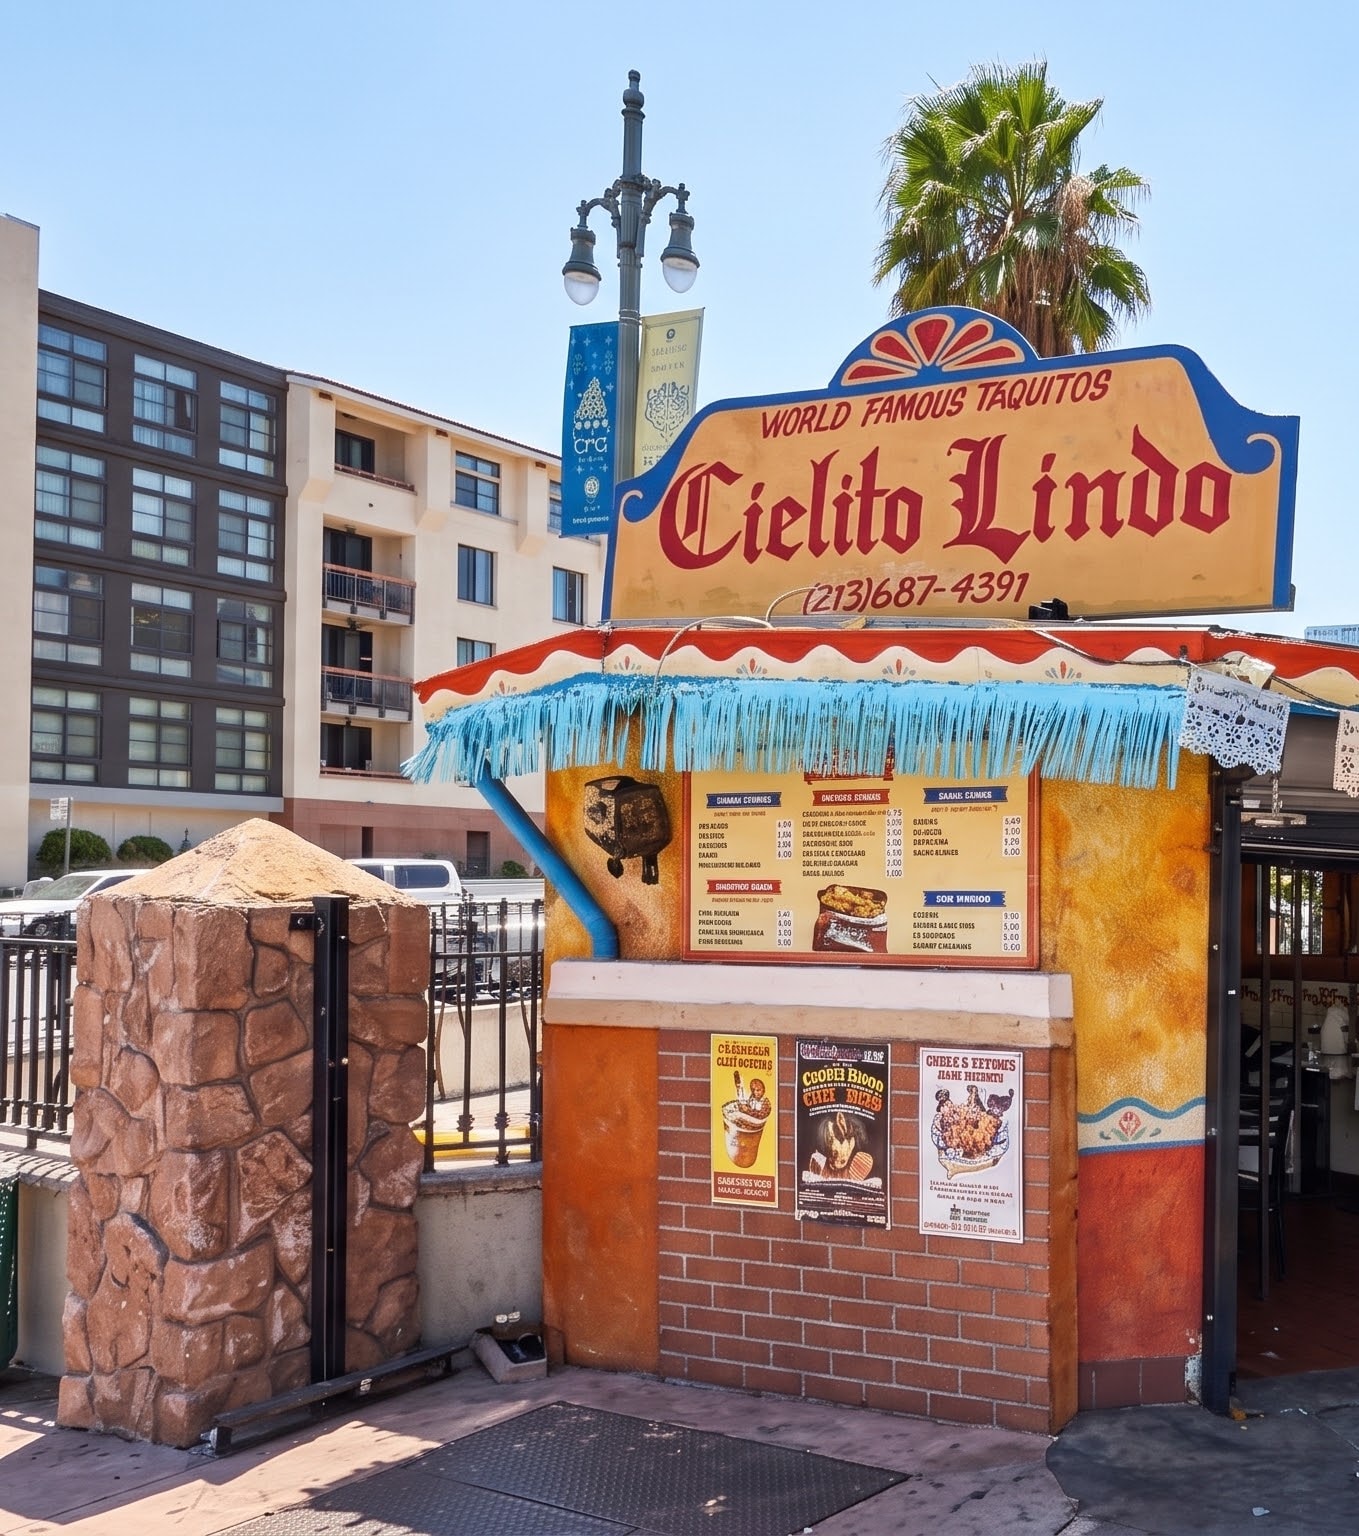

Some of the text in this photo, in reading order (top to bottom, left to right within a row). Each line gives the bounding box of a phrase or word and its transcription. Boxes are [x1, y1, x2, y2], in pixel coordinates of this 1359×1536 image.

[762, 369, 1111, 439] WORLD FAMOUS TAQUITOS
[658, 424, 1232, 570] Cielito Lindo
[803, 570, 1029, 615] (213)687-4391
